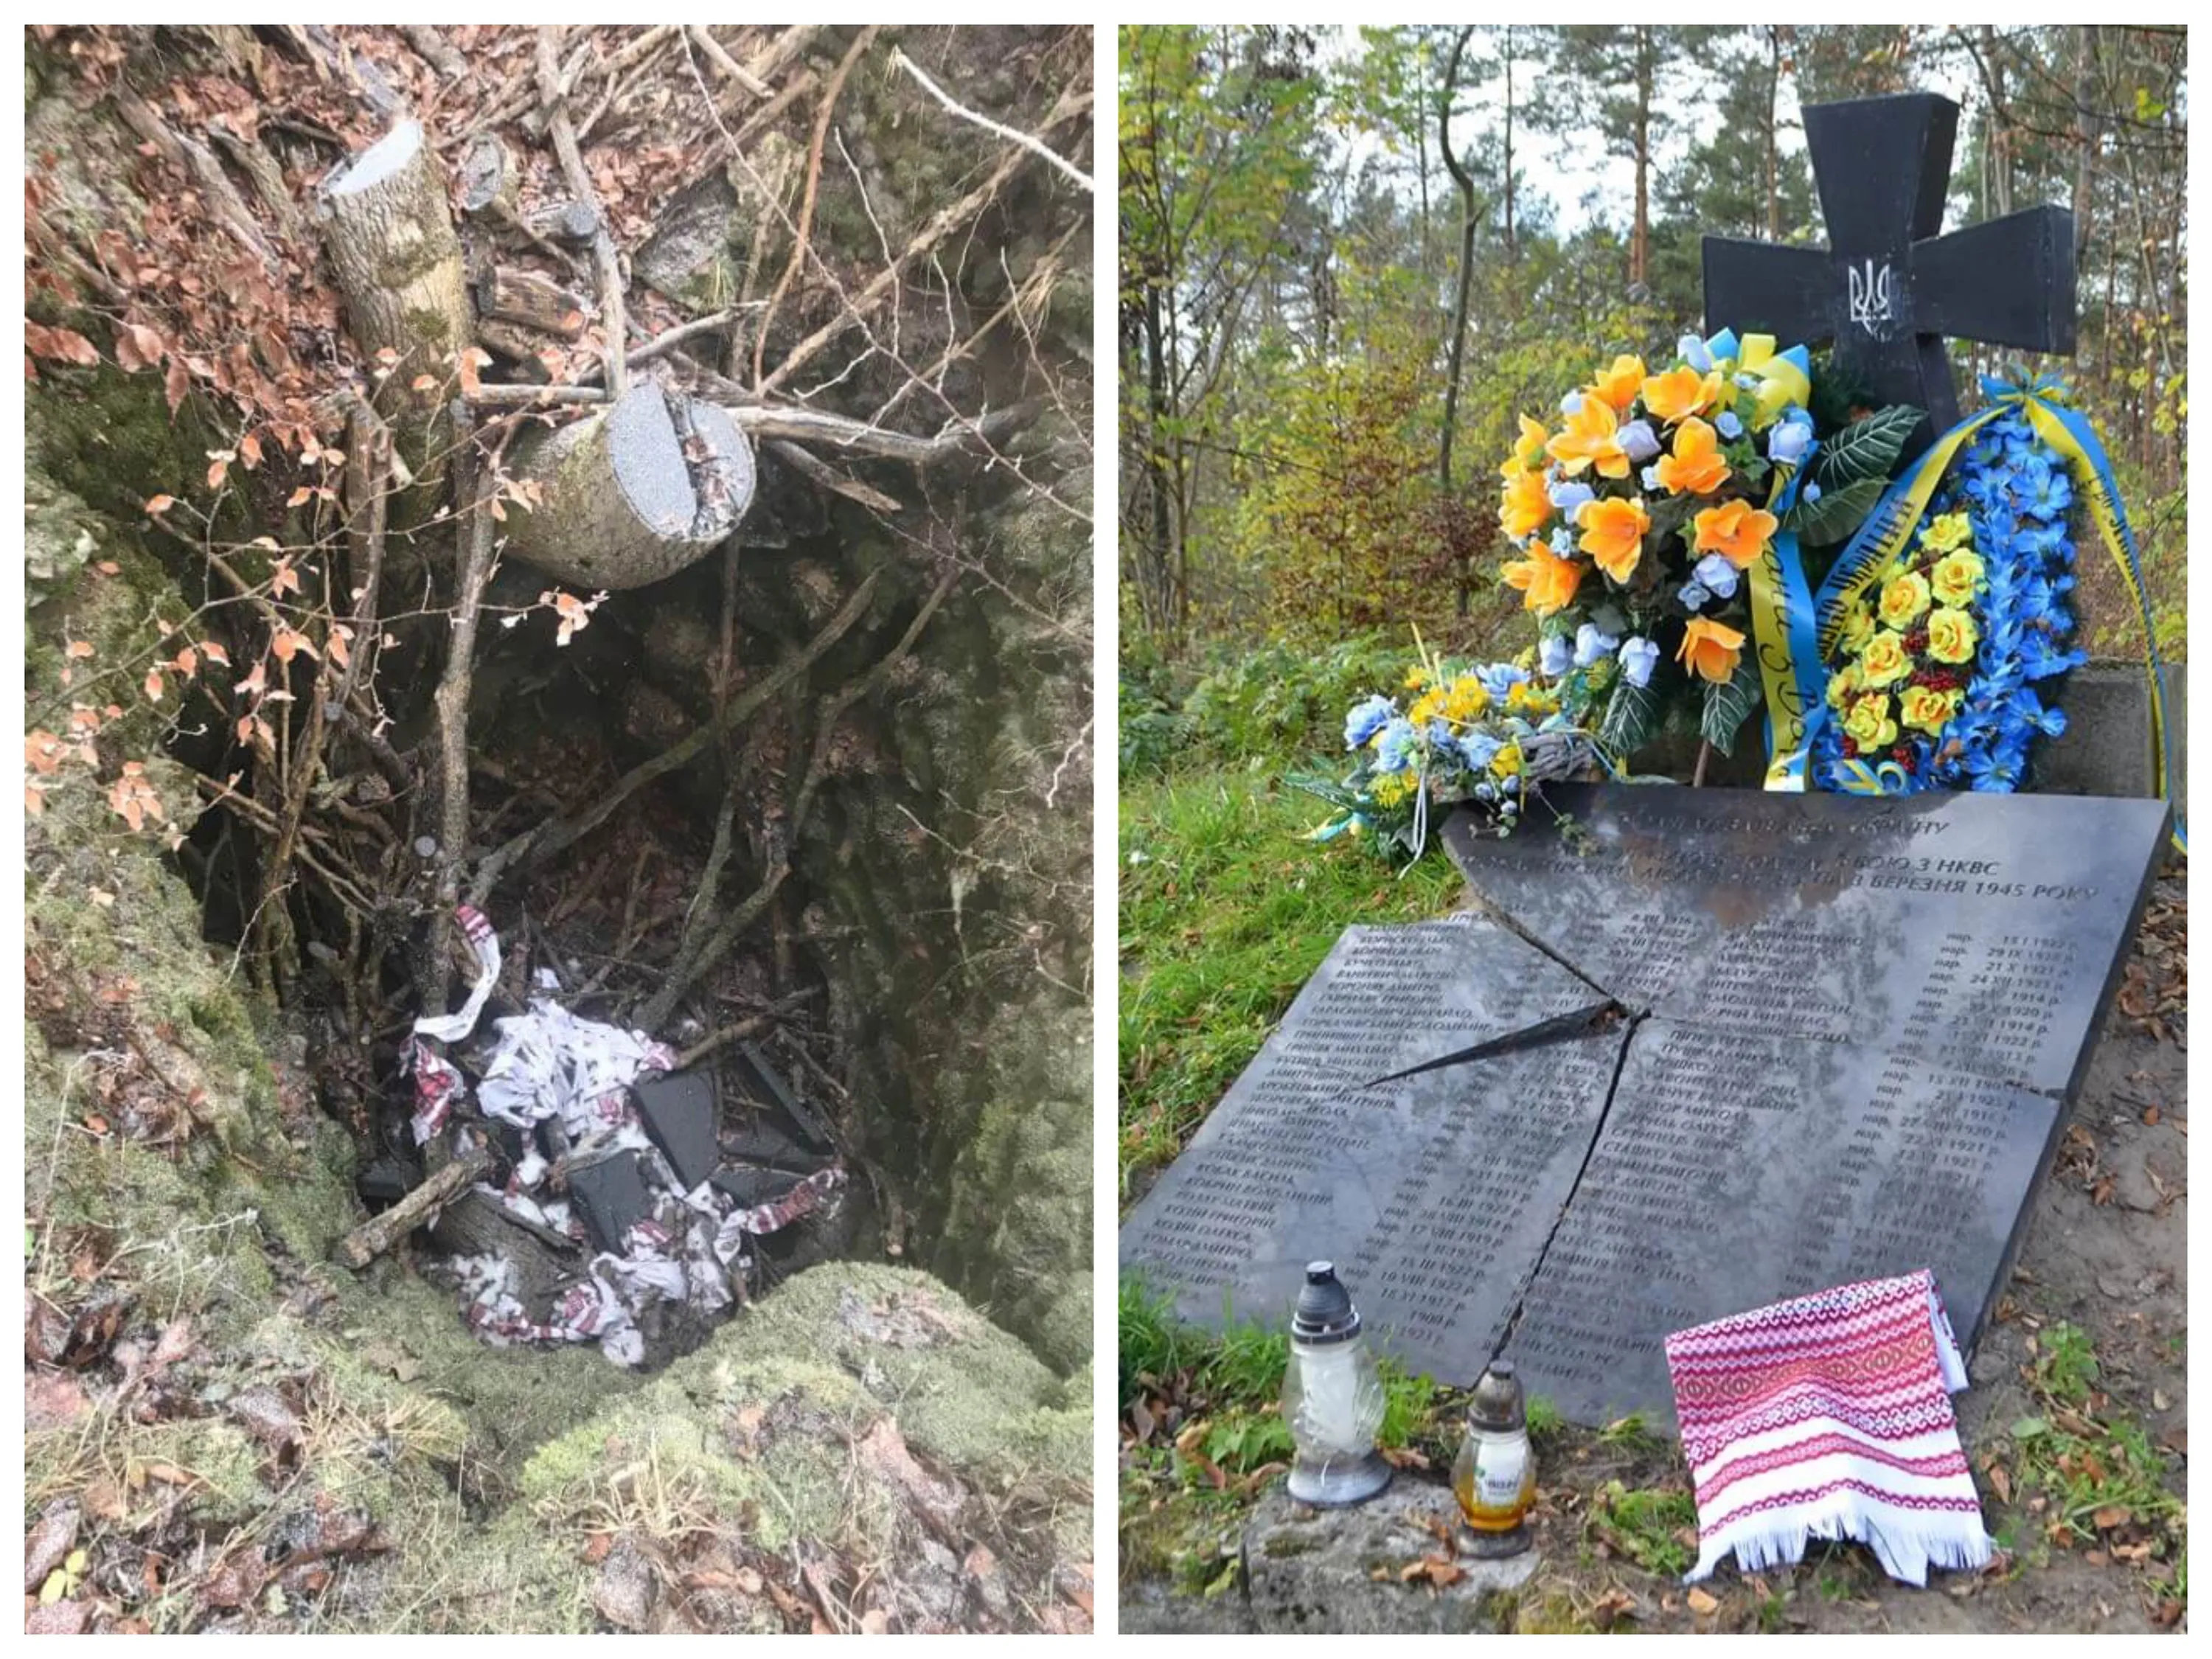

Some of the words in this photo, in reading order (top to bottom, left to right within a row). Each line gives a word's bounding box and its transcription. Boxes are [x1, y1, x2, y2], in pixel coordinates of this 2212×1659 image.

[1854, 856, 1910, 871] БОЮ
[1937, 859, 2001, 876] НКВС
[1870, 875, 1968, 893] БЕРЕЗНЯ
[1975, 883, 2025, 897] 1945
[2031, 885, 2100, 901] РОКУ
